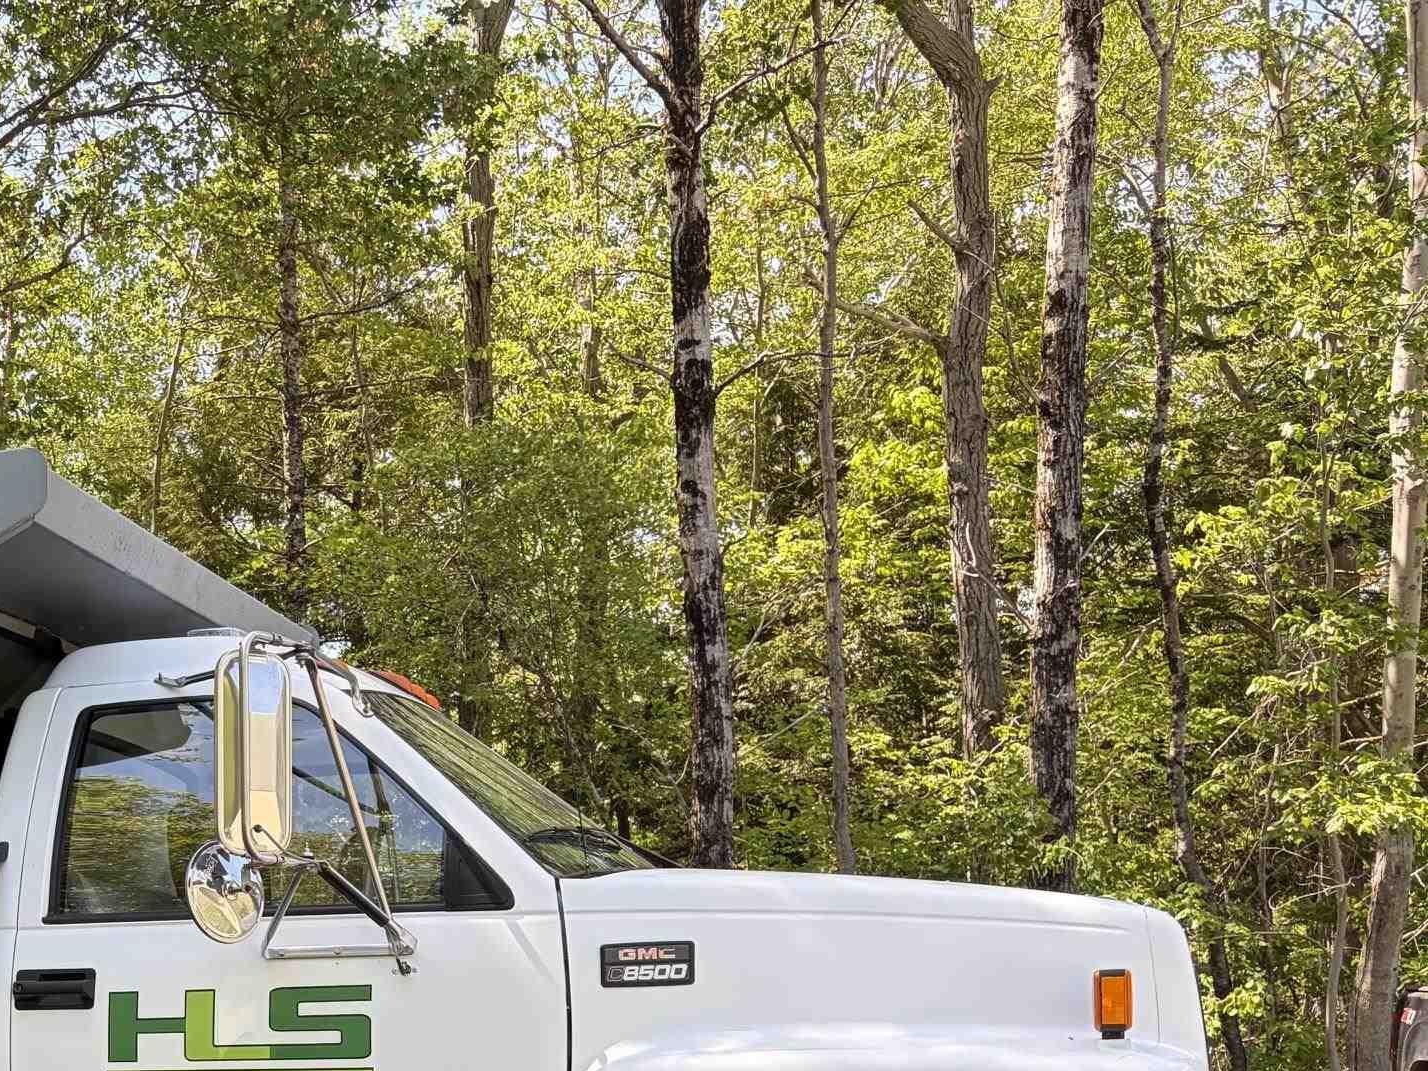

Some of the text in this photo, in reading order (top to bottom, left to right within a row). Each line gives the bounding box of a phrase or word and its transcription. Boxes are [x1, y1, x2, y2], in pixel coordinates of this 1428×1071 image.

[618, 947, 676, 961] GMC
[606, 963, 689, 982] C8500
[108, 984, 372, 1062] HLS
